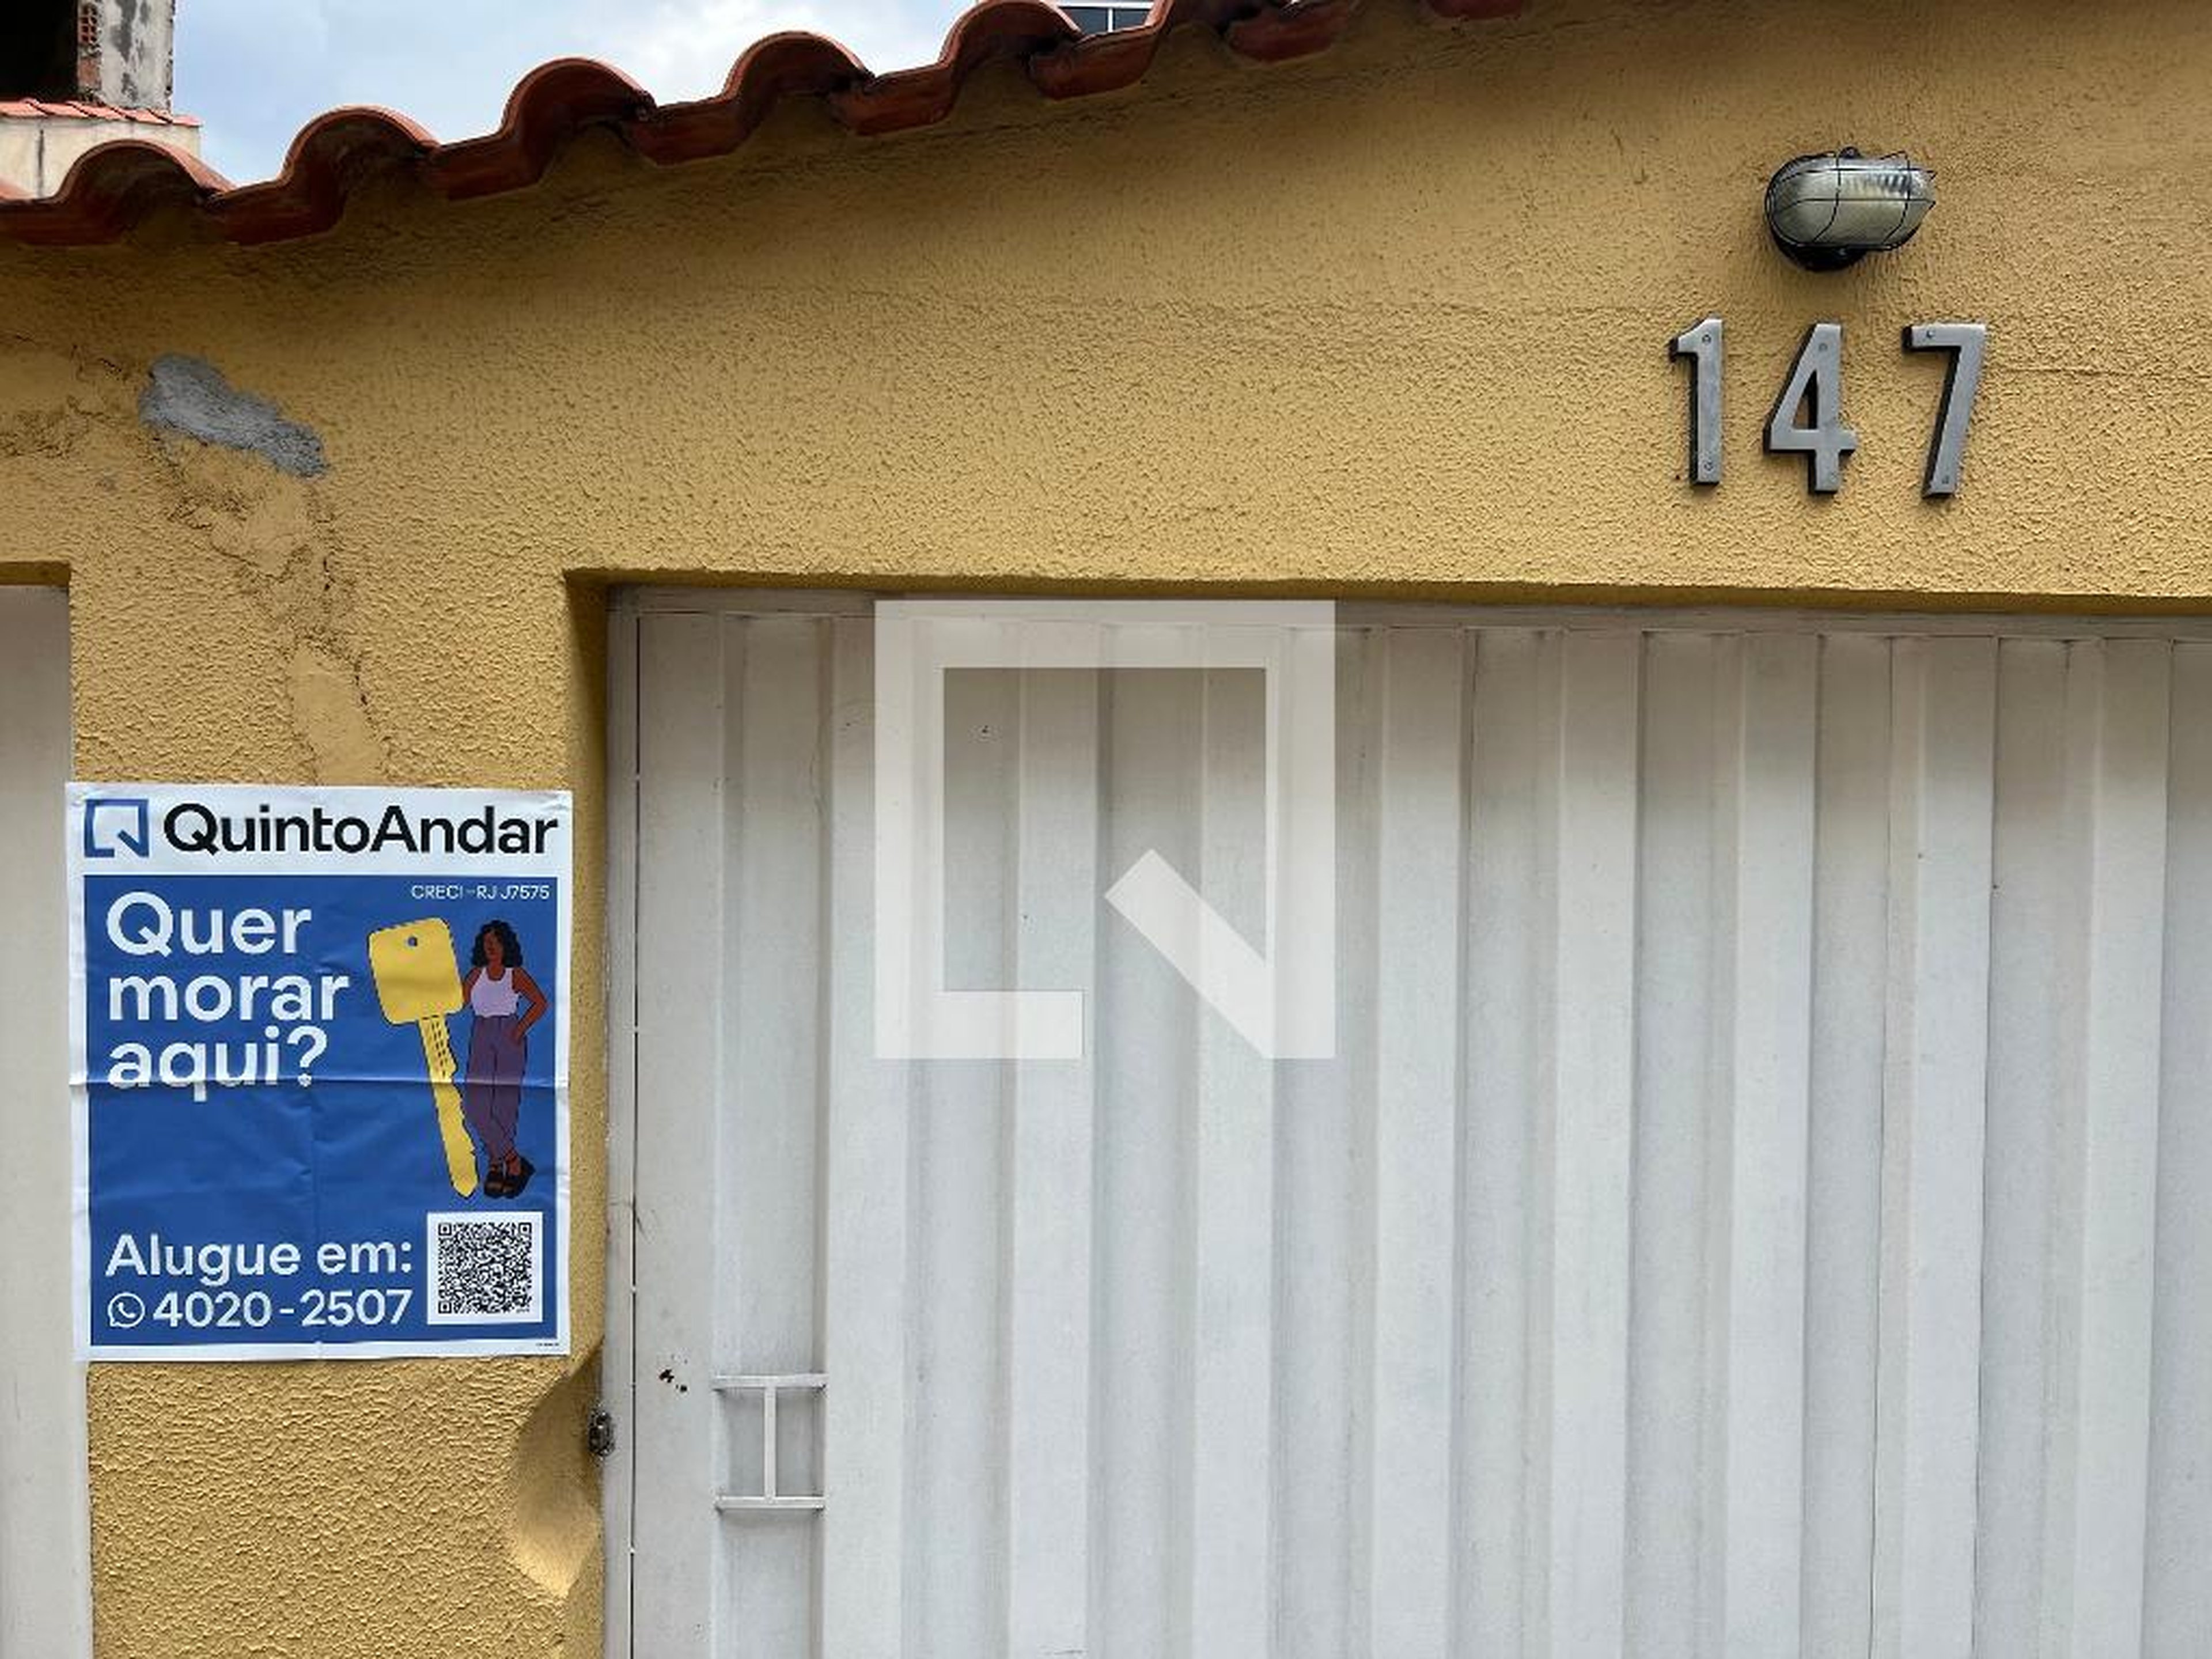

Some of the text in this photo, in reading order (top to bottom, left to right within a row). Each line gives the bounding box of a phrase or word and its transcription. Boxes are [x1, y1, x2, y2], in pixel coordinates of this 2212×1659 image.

[1670, 317, 1987, 499] 147
[164, 803, 559, 856] QuintoAndar
[500, 885, 550, 900] J7575
[106, 891, 312, 957] Quer
[109, 974, 350, 1022] morar
[107, 1025, 327, 1102] aqui?
[105, 1234, 412, 1286] Alugue em:
